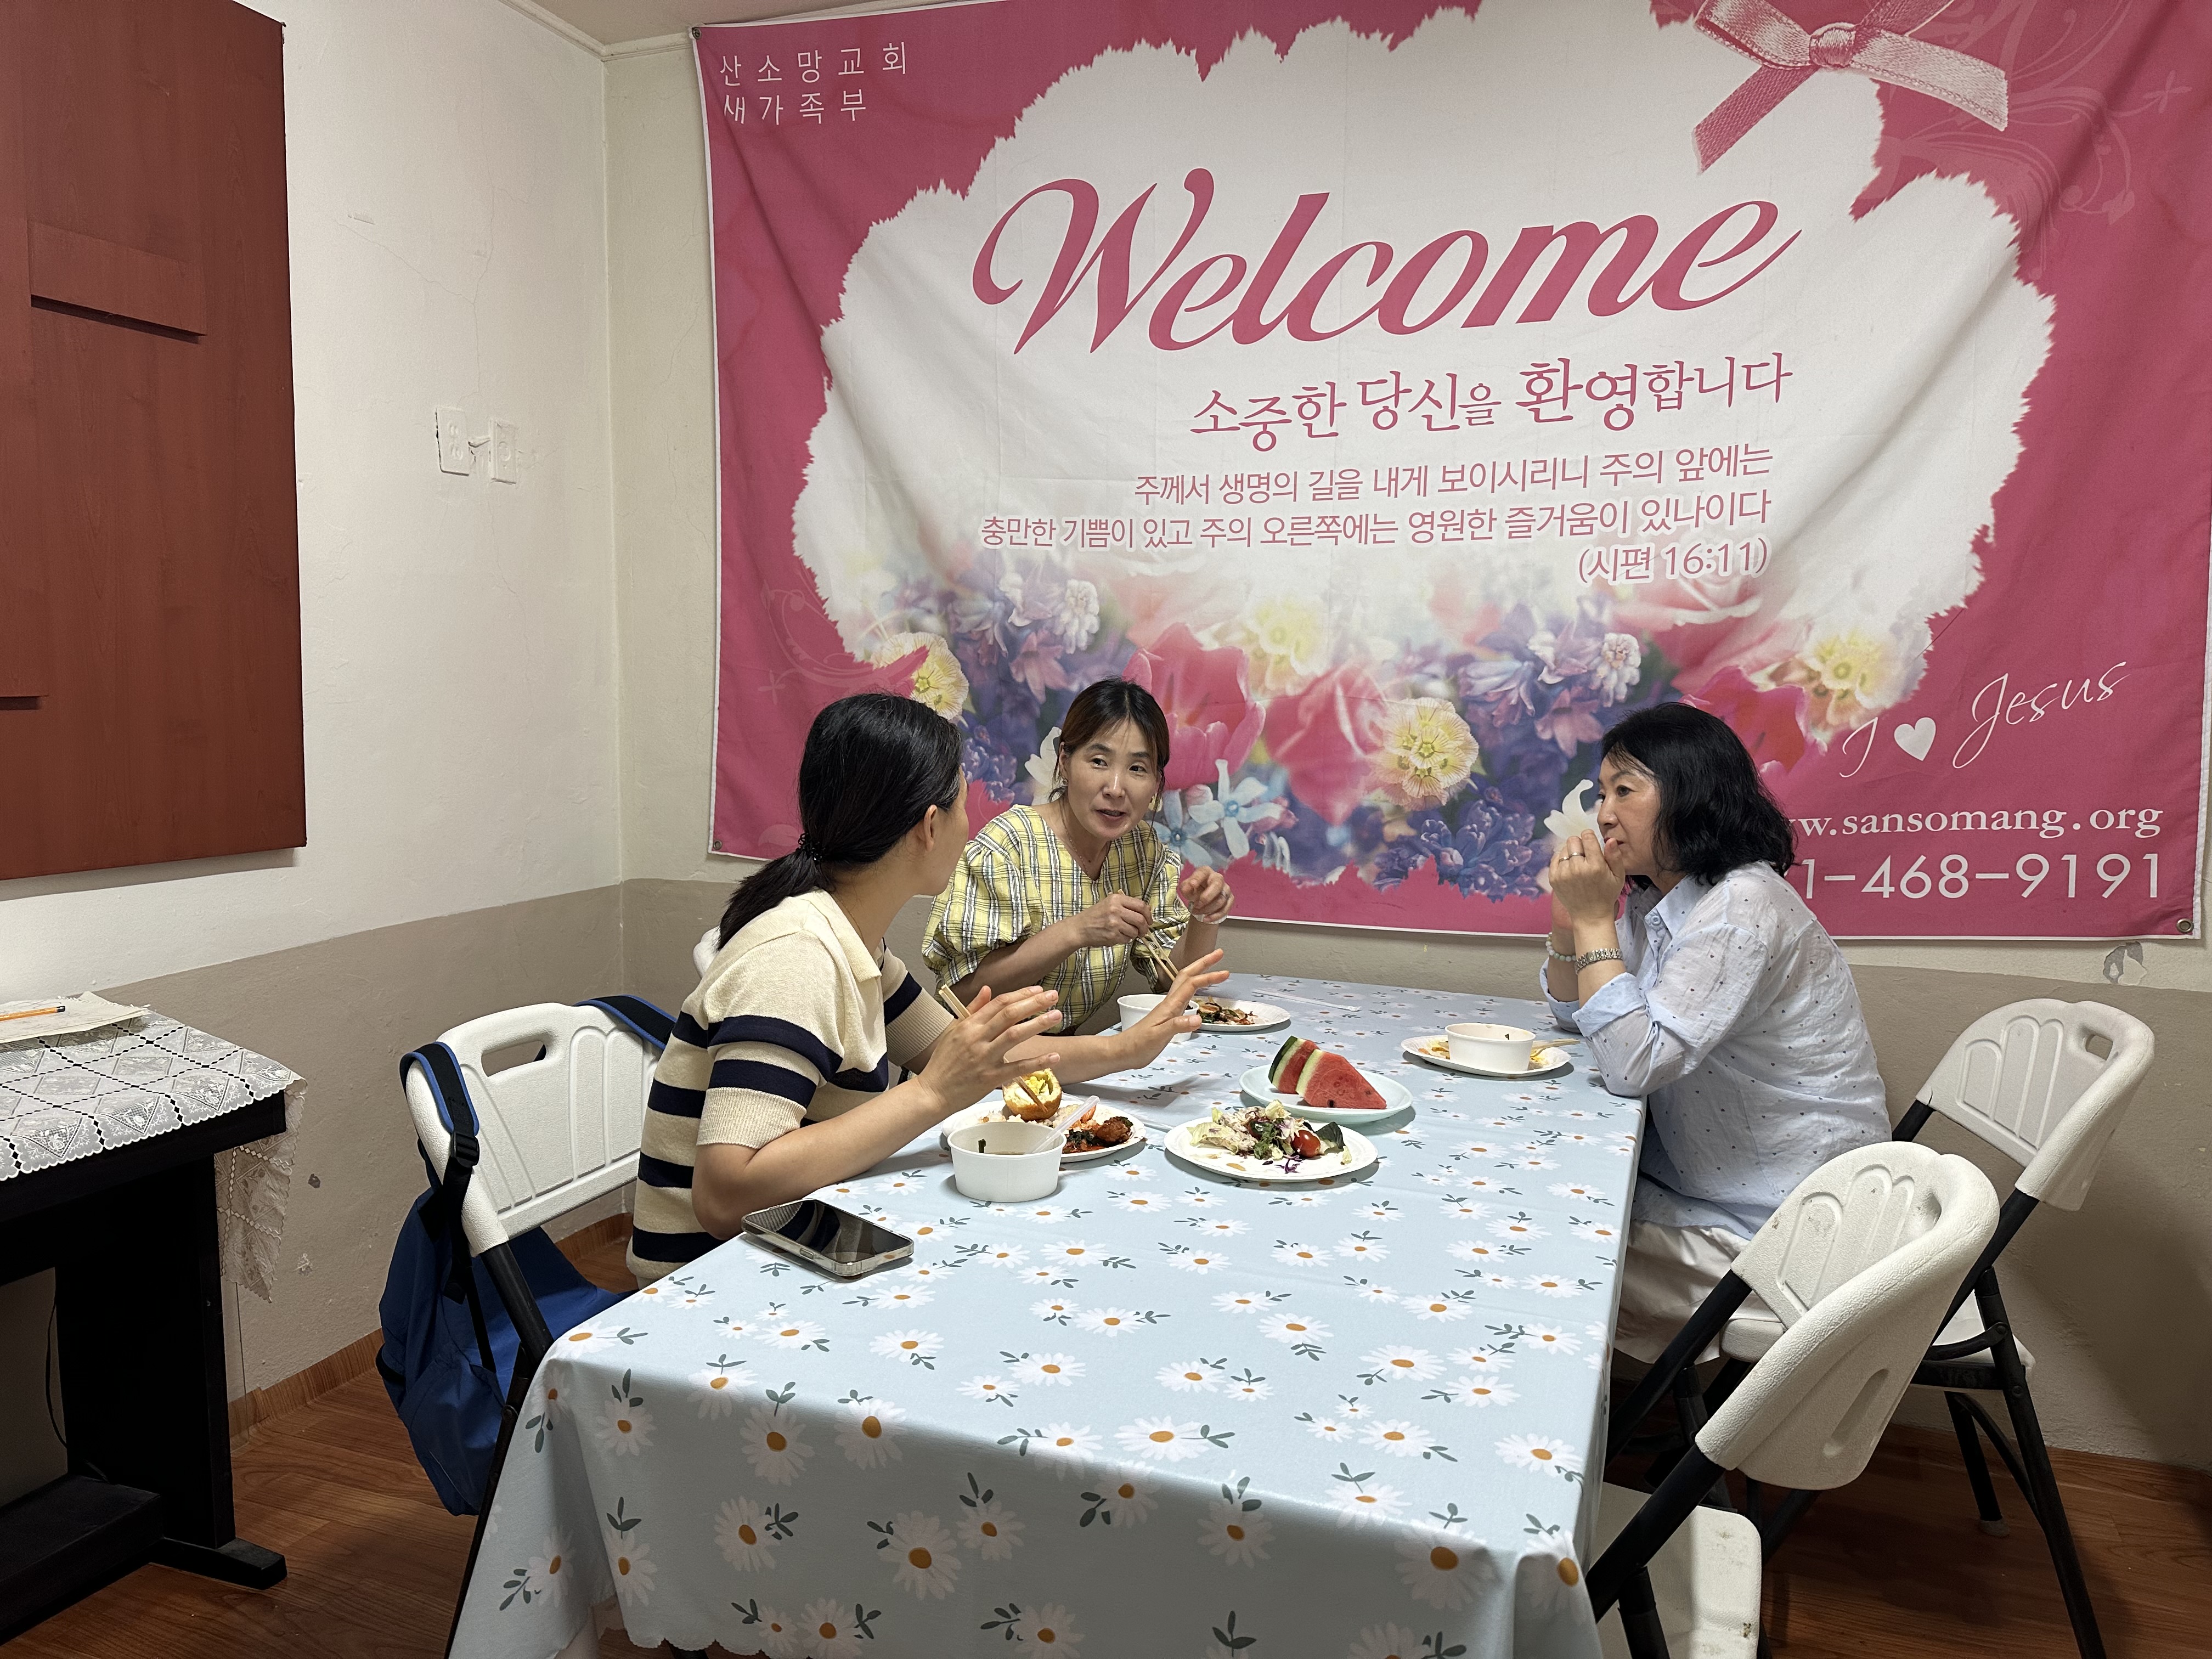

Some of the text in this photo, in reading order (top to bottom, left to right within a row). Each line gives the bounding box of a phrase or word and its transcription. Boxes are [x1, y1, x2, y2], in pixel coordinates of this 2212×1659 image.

[971, 167, 1803, 355] Welcome
[1189, 352, 1793, 452] 소중한 당신을 환영합니다
[1135, 443, 1773, 505] 주께서 생명의 길을 내게 보이시리니 주의 앞에는
[981, 489, 1771, 549] 충만한 기쁨이 있고 주의 오른쪽에는 영원한 즐거움이 있나이다
[1578, 537, 1768, 584] (시편 16:11)
[1952, 661, 2131, 769] Jesus
[1788, 808, 2164, 839] w.sansomang.org
[1784, 853, 2159, 900] 1-468-9191
